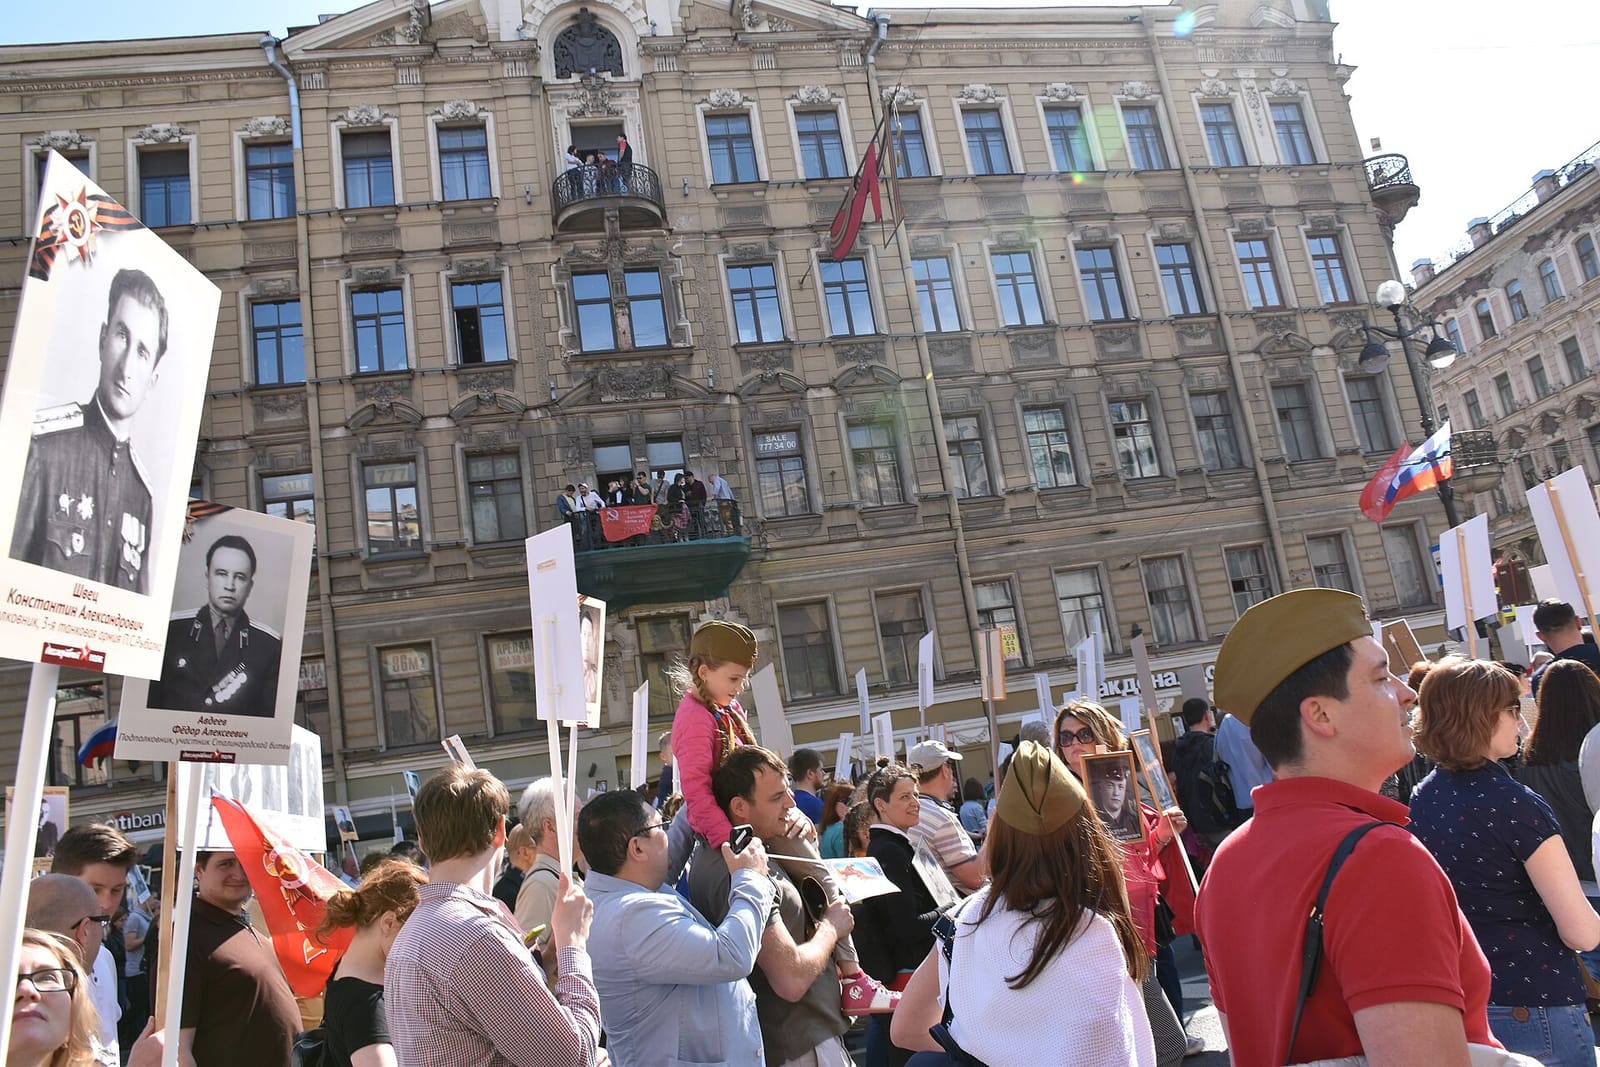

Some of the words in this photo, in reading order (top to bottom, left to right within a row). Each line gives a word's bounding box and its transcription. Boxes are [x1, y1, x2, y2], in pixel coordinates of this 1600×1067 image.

[766, 435, 787, 443] SALE
[759, 443, 773, 451] 777
[73, 582, 99, 603] Швец
[6, 587, 78, 617] Константин
[78, 605, 145, 631] Александрович
[0, 610, 39, 630] лковник,
[197, 715, 227, 727] Авдеев
[172, 724, 201, 737] Фёдор
[201, 727, 249, 738] Алексеевич
[211, 738, 268, 749] Сталинградской
